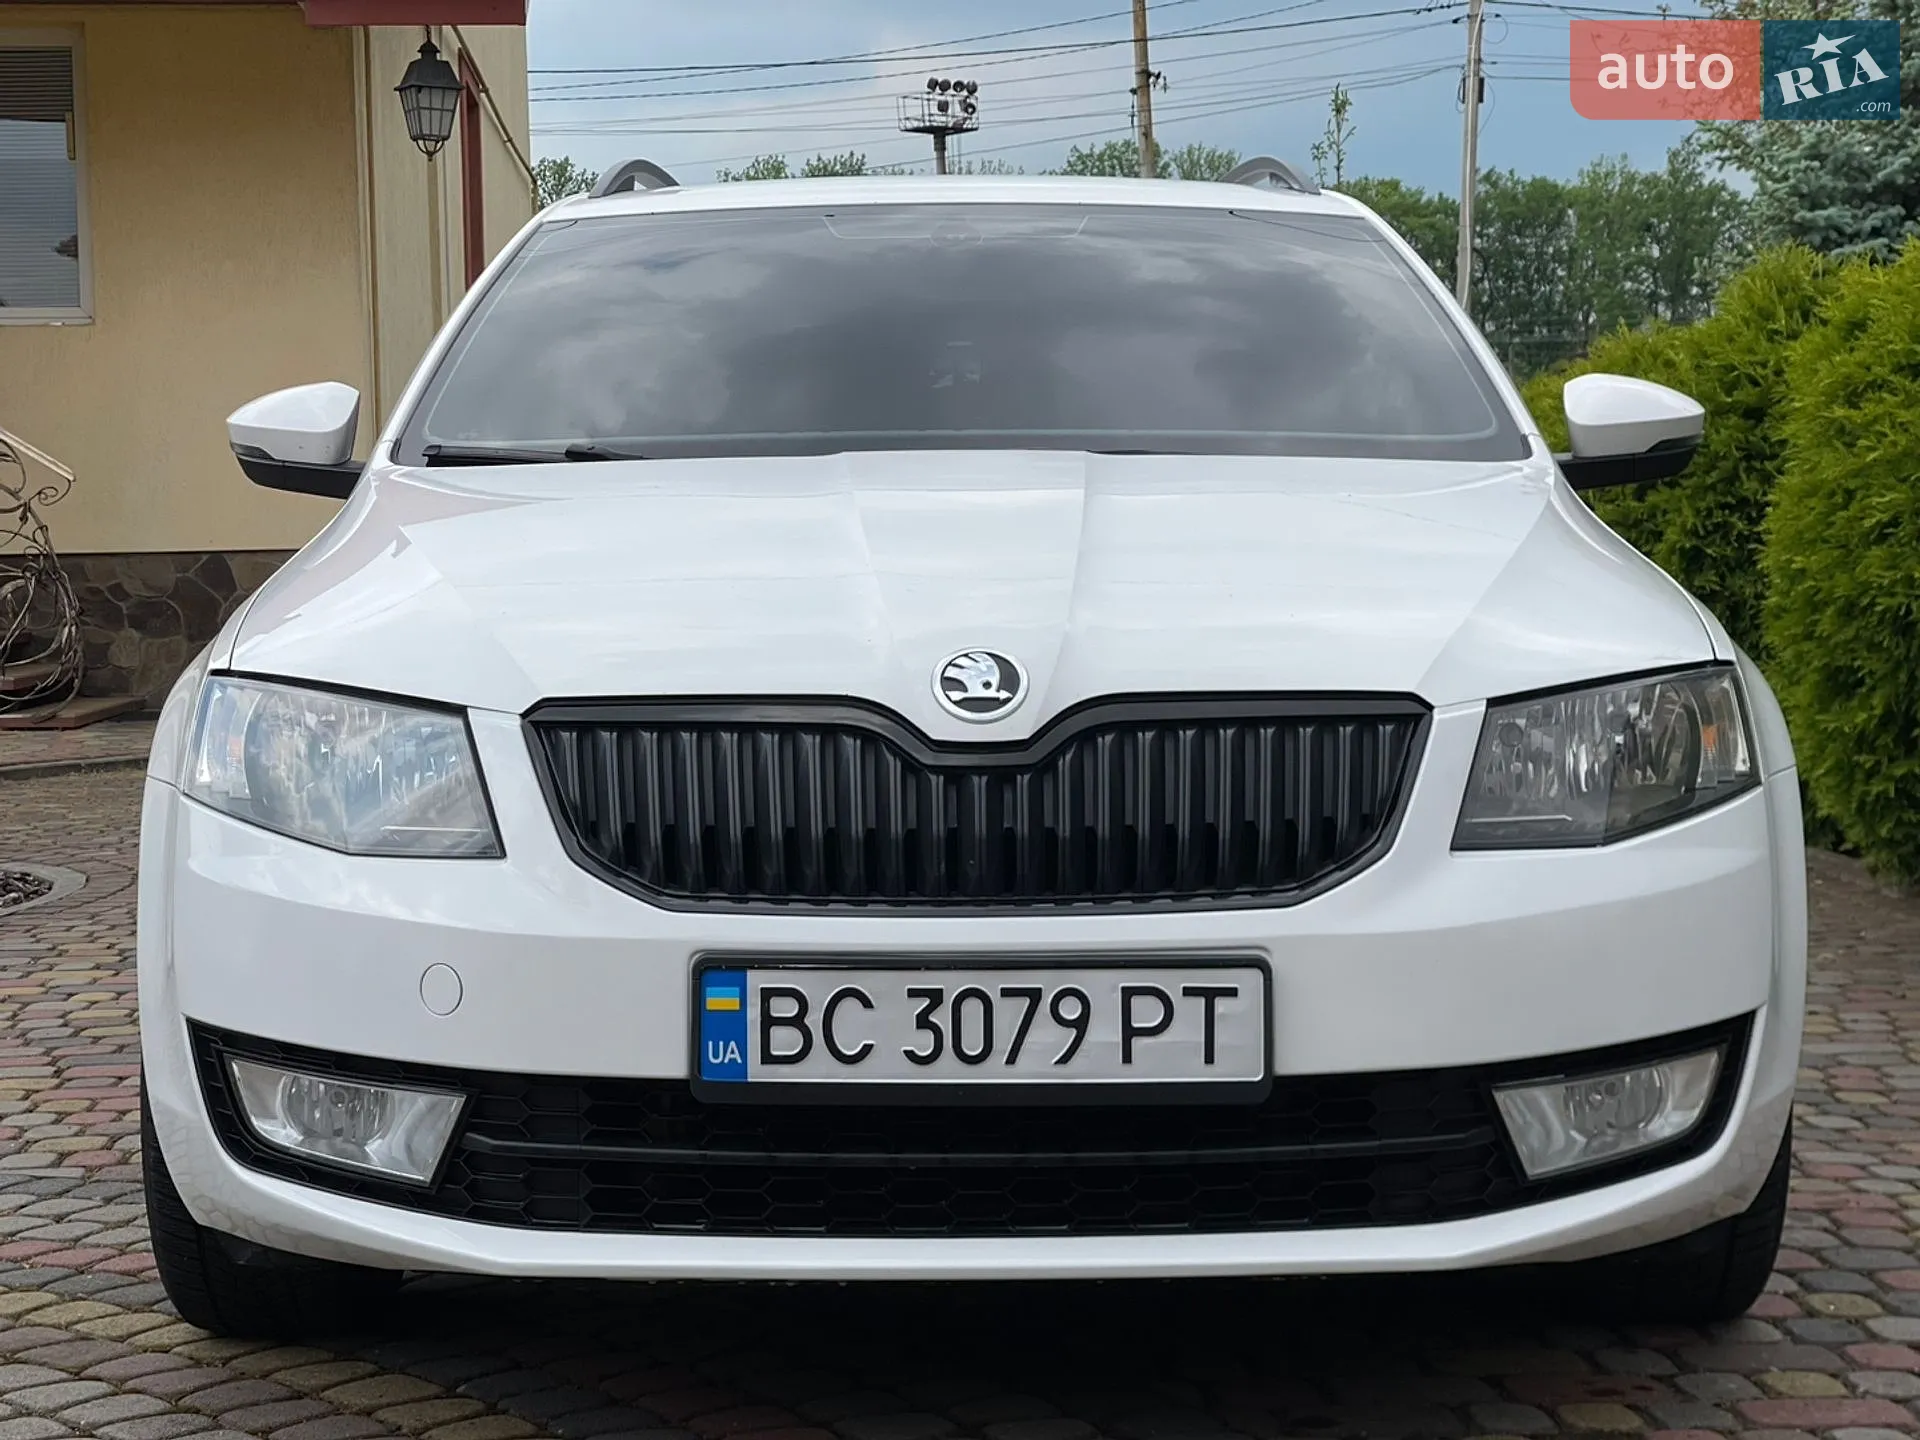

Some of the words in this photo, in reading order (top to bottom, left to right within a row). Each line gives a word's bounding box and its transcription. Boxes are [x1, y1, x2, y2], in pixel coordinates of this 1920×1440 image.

[760, 985, 875, 1065] BC
[902, 985, 1091, 1065] 3079
[1120, 985, 1238, 1065] PT
[707, 1040, 742, 1064] UA
